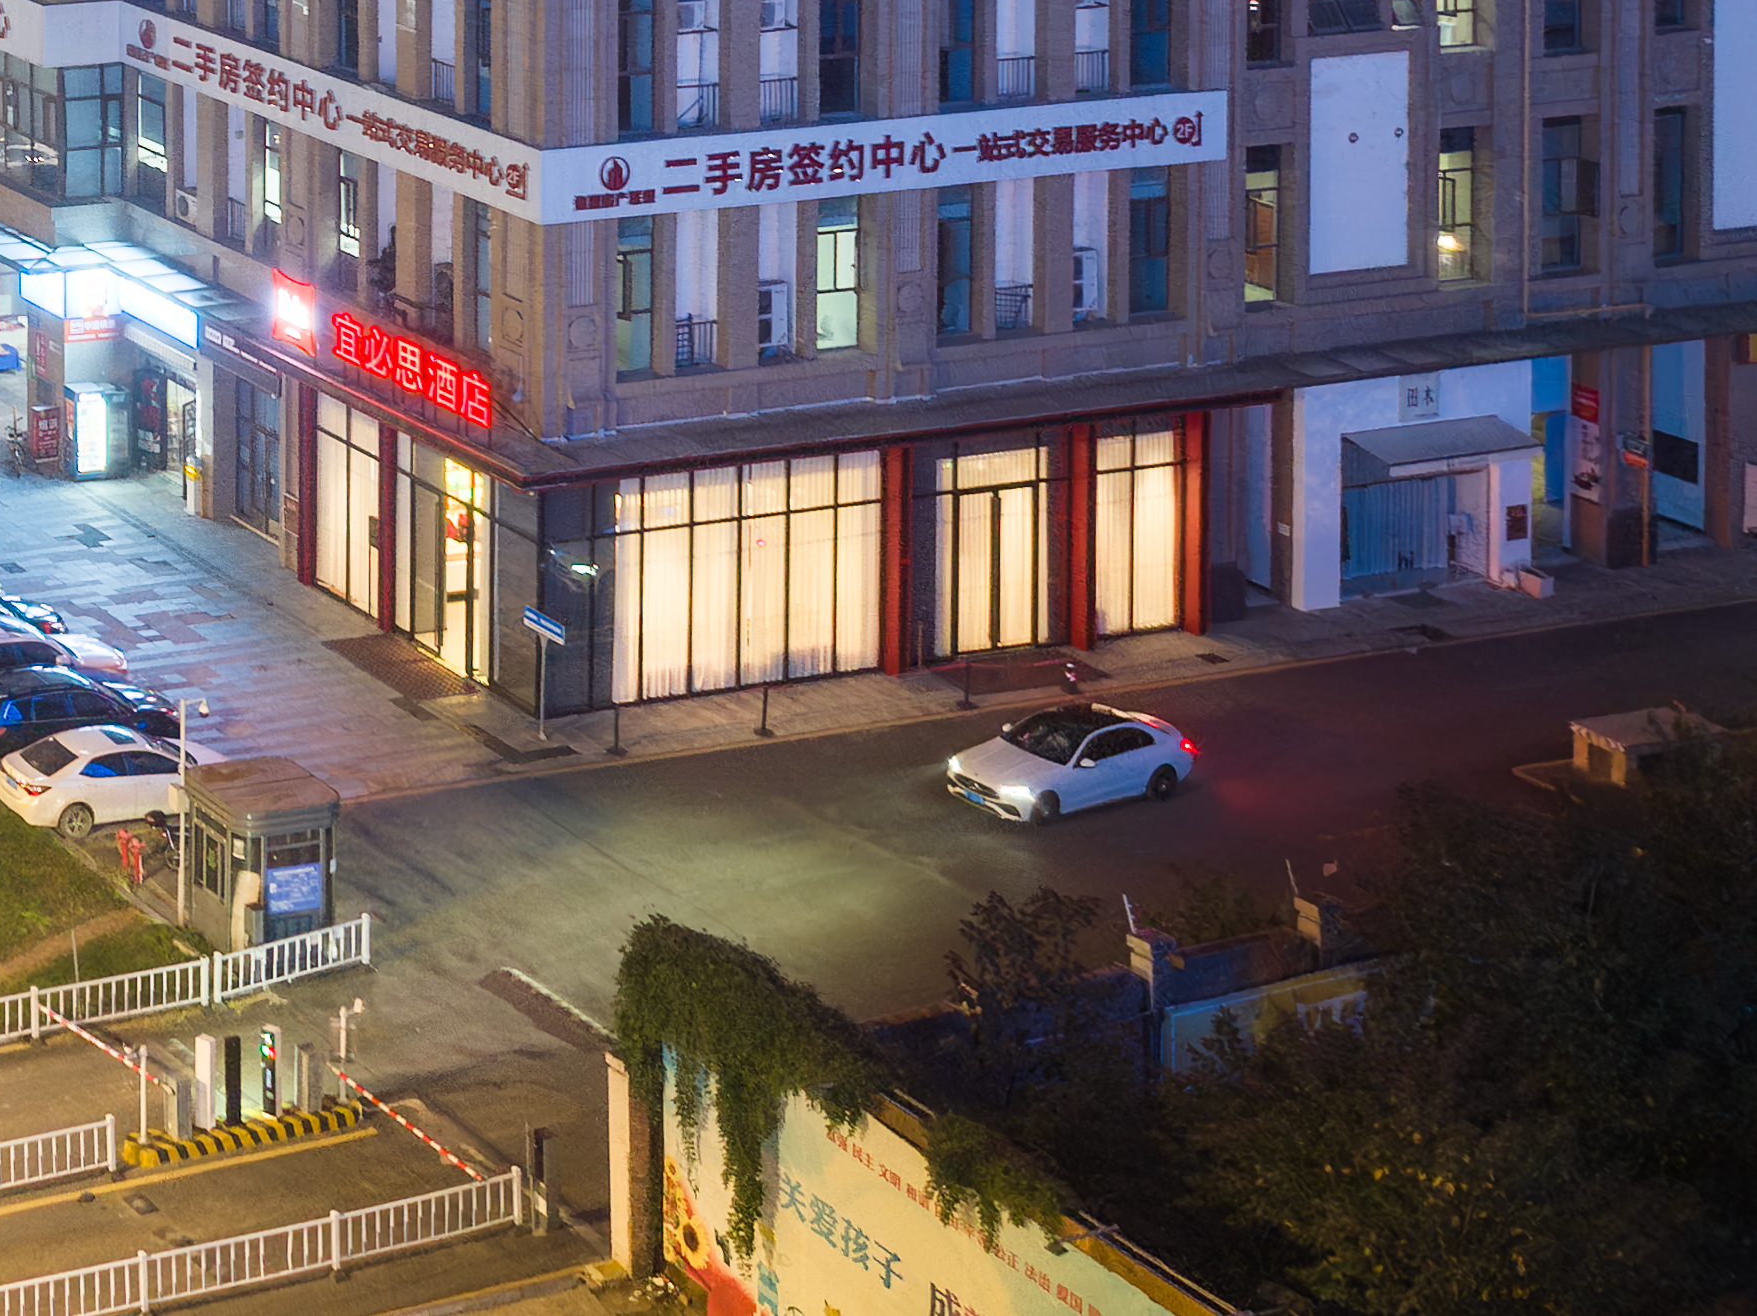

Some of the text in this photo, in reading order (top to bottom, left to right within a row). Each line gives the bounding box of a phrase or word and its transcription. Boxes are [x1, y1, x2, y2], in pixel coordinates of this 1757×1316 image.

[171, 34, 345, 131] 二手房签约中心
[345, 111, 505, 187] 一站式交易服务中心
[662, 132, 947, 197] 二手房签约中心
[951, 117, 1169, 165] 一站式交易服务中心
[332, 312, 492, 428] 宜必思酒店
[780, 1175, 904, 1291] 关爱孩子
[851, 1142, 875, 1172] 民主
[878, 1162, 902, 1191] 文明
[993, 1243, 1020, 1272] 公正
